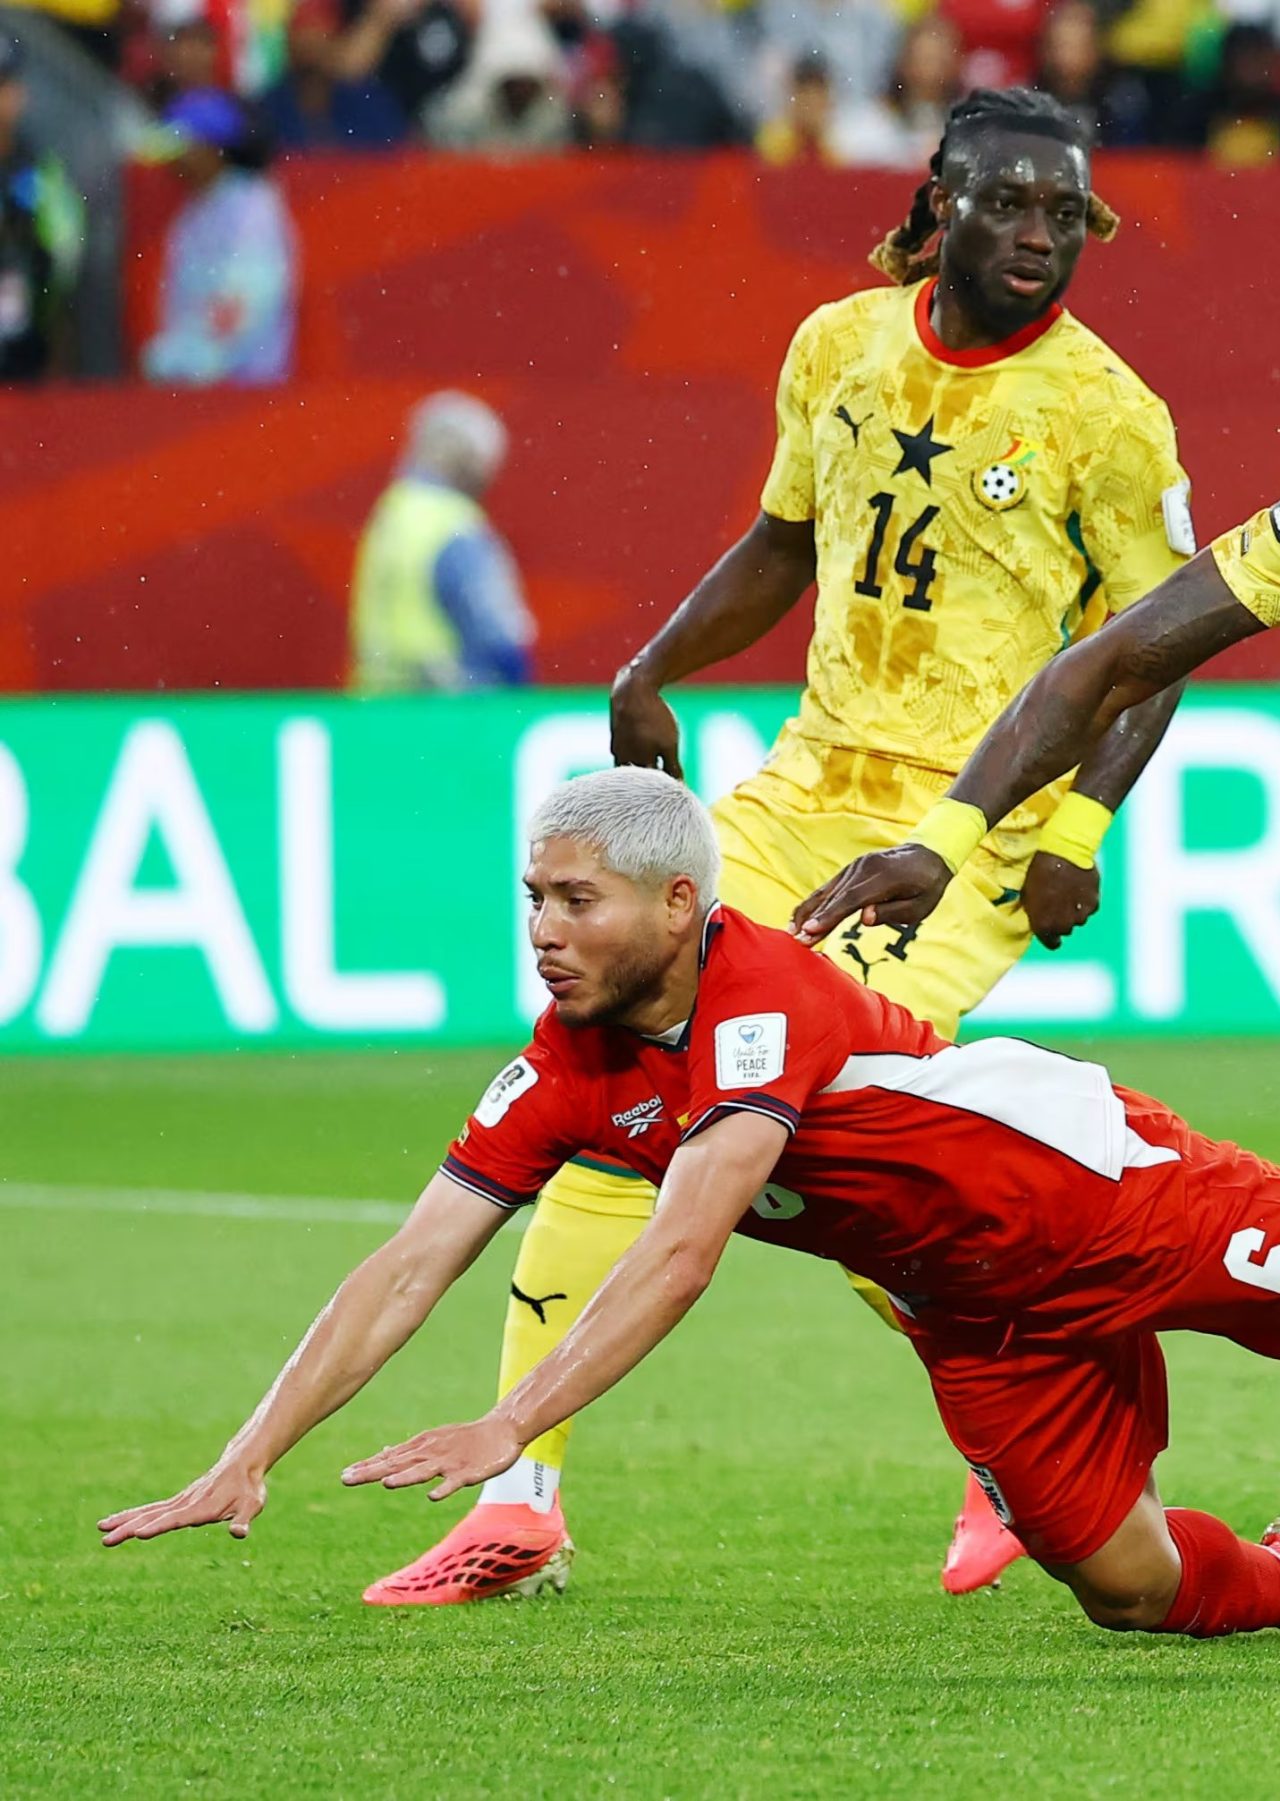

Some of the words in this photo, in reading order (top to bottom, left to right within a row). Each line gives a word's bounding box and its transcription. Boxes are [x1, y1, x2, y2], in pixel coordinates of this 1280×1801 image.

[854, 491, 941, 612] 14
[0, 716, 448, 1036] AL
[736, 1058, 767, 1071] PEACE
